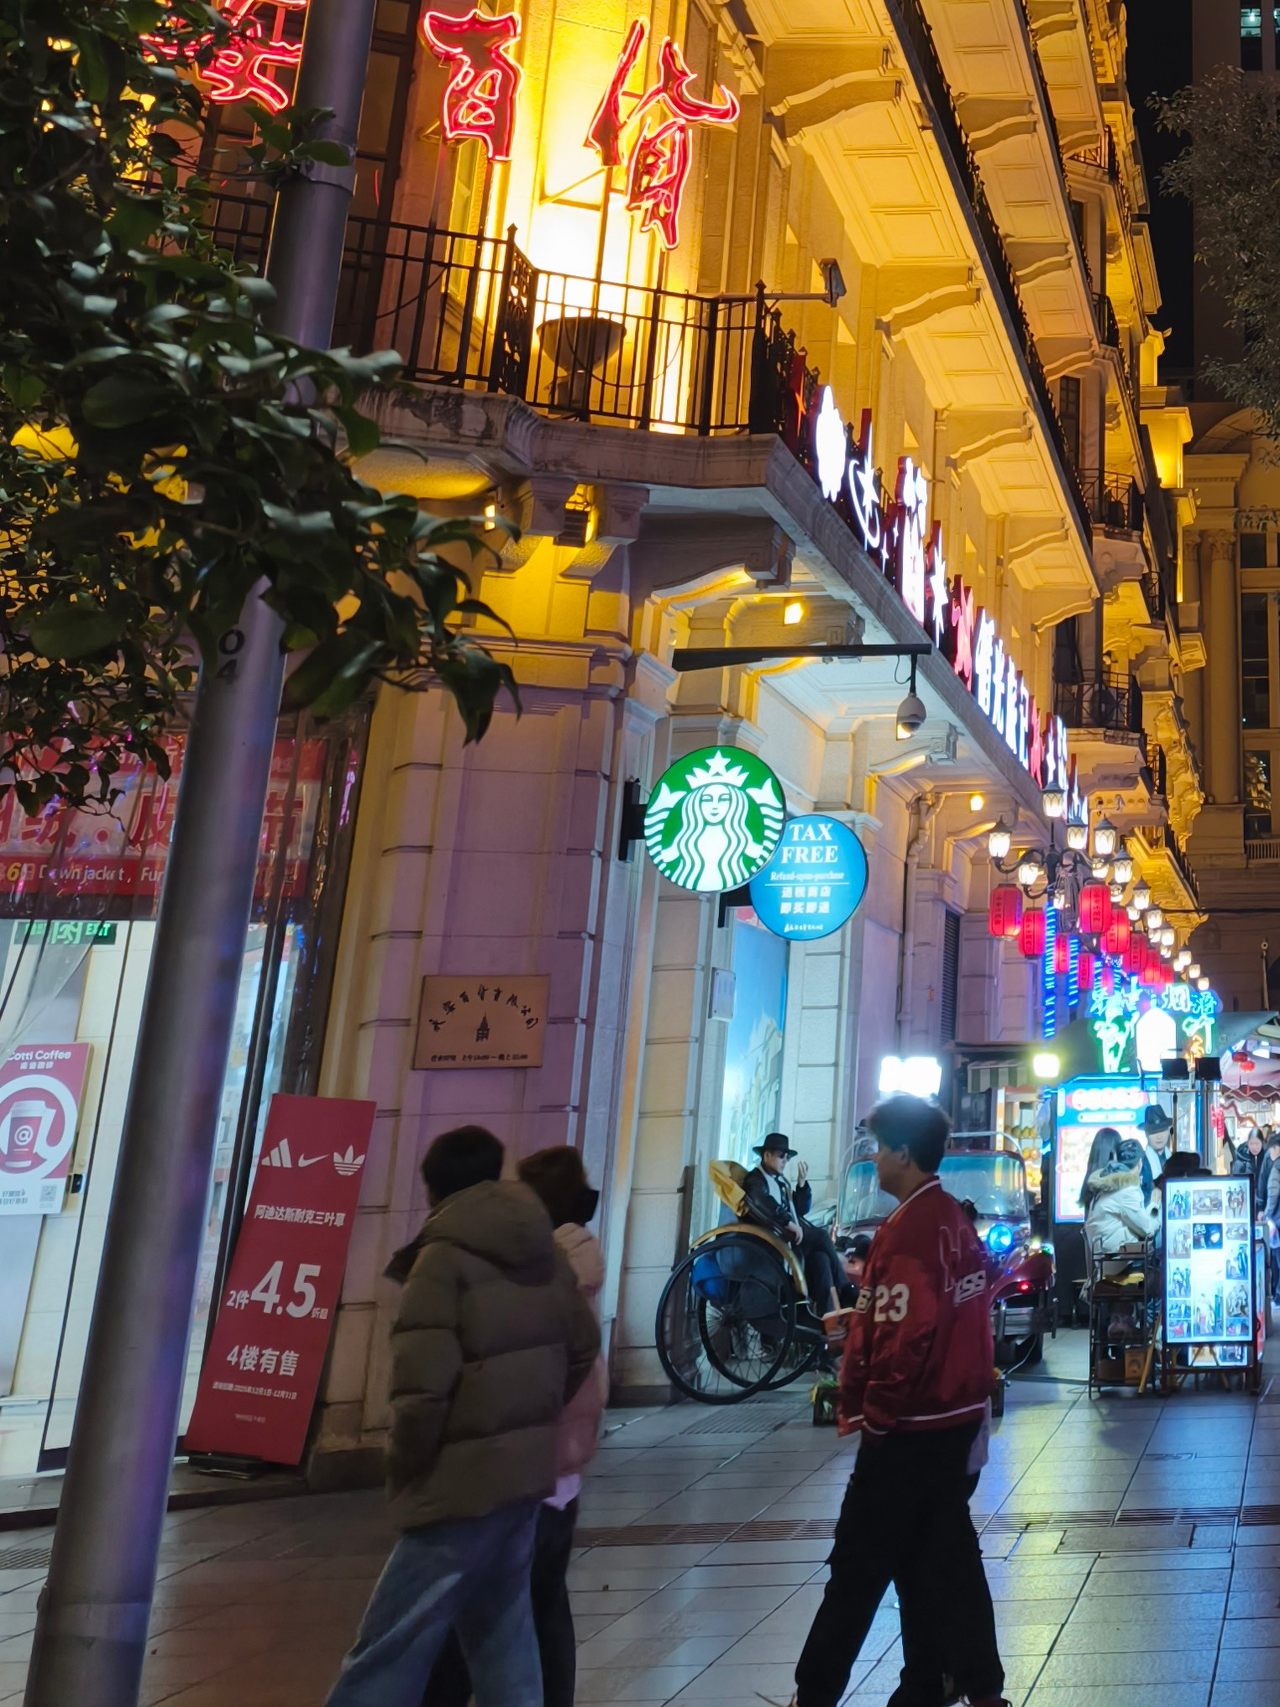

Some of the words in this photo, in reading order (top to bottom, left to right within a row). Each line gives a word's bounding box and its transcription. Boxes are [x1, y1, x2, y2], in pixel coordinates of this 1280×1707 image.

[789, 823, 834, 842] TAX
[781, 845, 838, 864] FREE
[35, 1049, 72, 1060] Coffee
[873, 1283, 910, 1323] 23
[226, 1344, 300, 1377] 4楼有售
